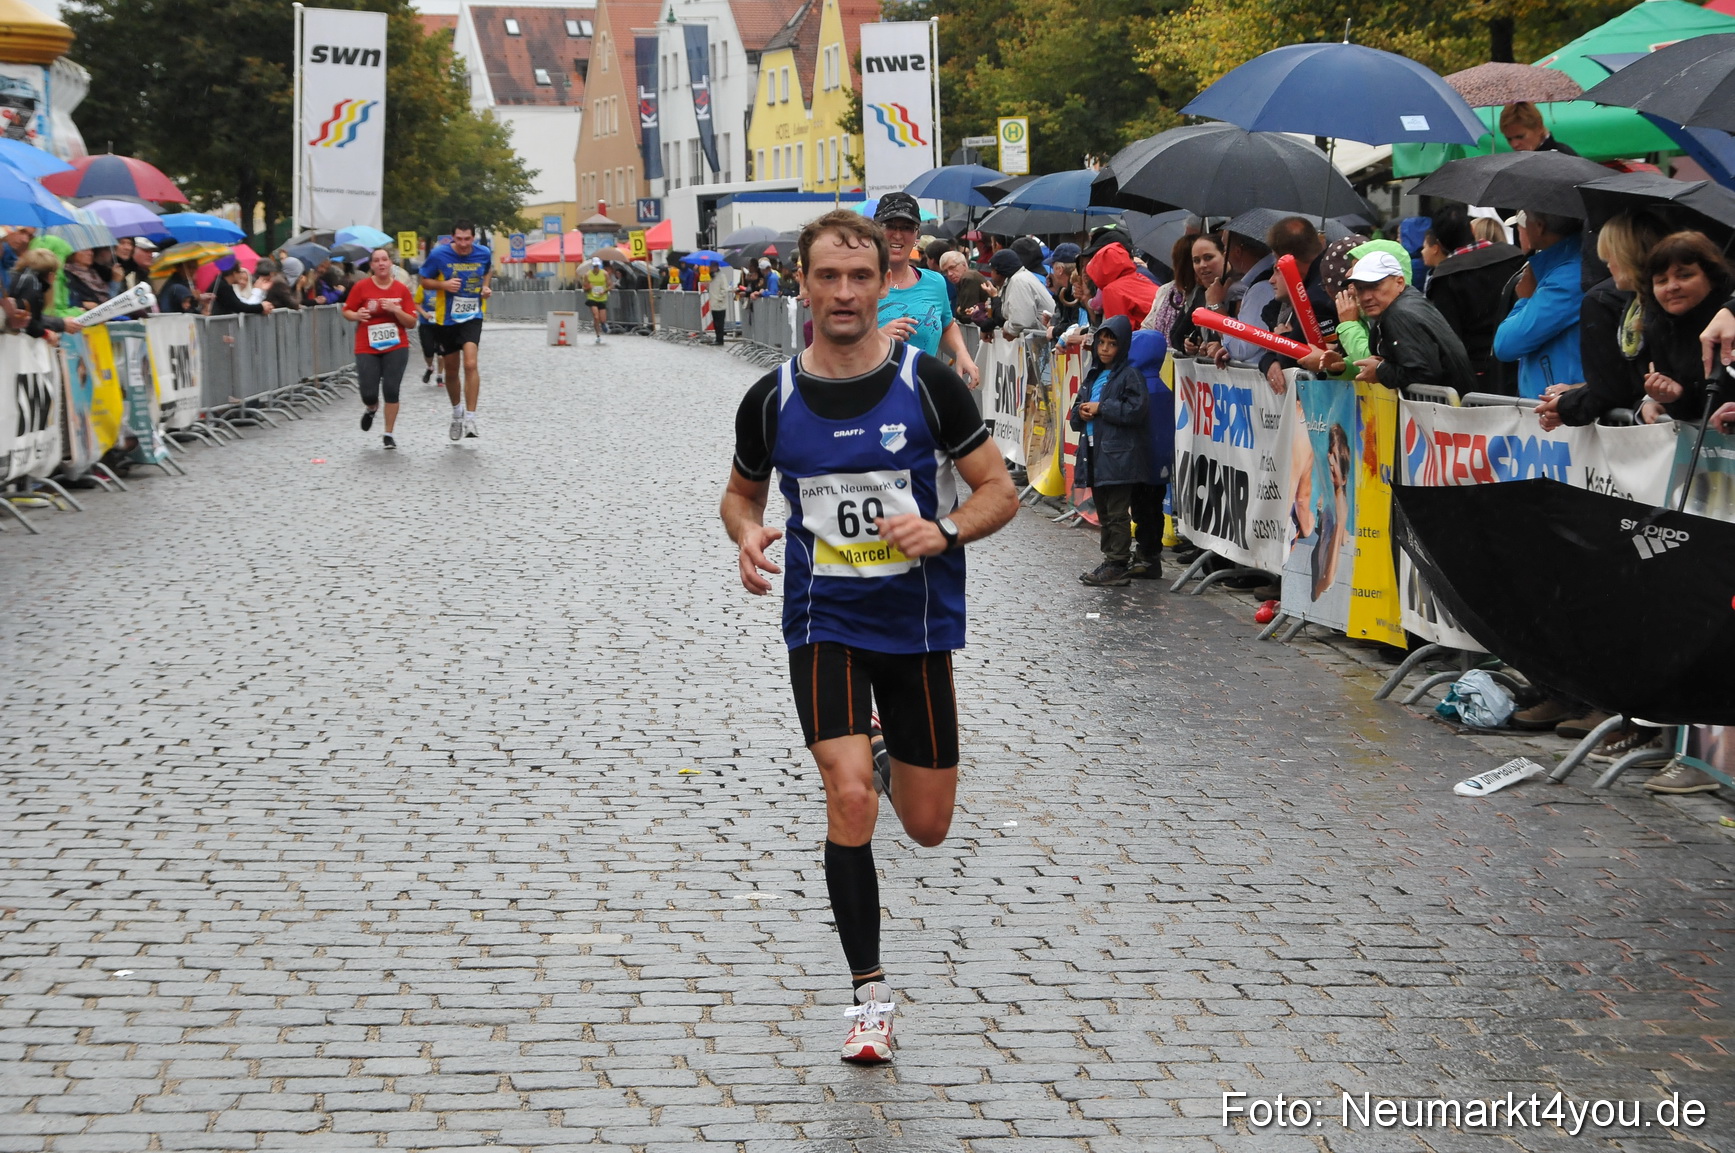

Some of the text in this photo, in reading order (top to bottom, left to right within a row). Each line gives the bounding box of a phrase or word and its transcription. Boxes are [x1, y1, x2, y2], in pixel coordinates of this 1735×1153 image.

[310, 44, 381, 67] swn
[403, 239, 412, 251] D
[634, 238, 642, 251] D
[454, 303, 477, 313] 2384
[371, 329, 396, 341] 2306
[1253, 328, 1298, 349] Audi BKK
[834, 428, 859, 437] CRAFT
[801, 481, 893, 498] PARTL Neumarkt
[837, 497, 885, 539] 69
[839, 545, 891, 564] Marcel
